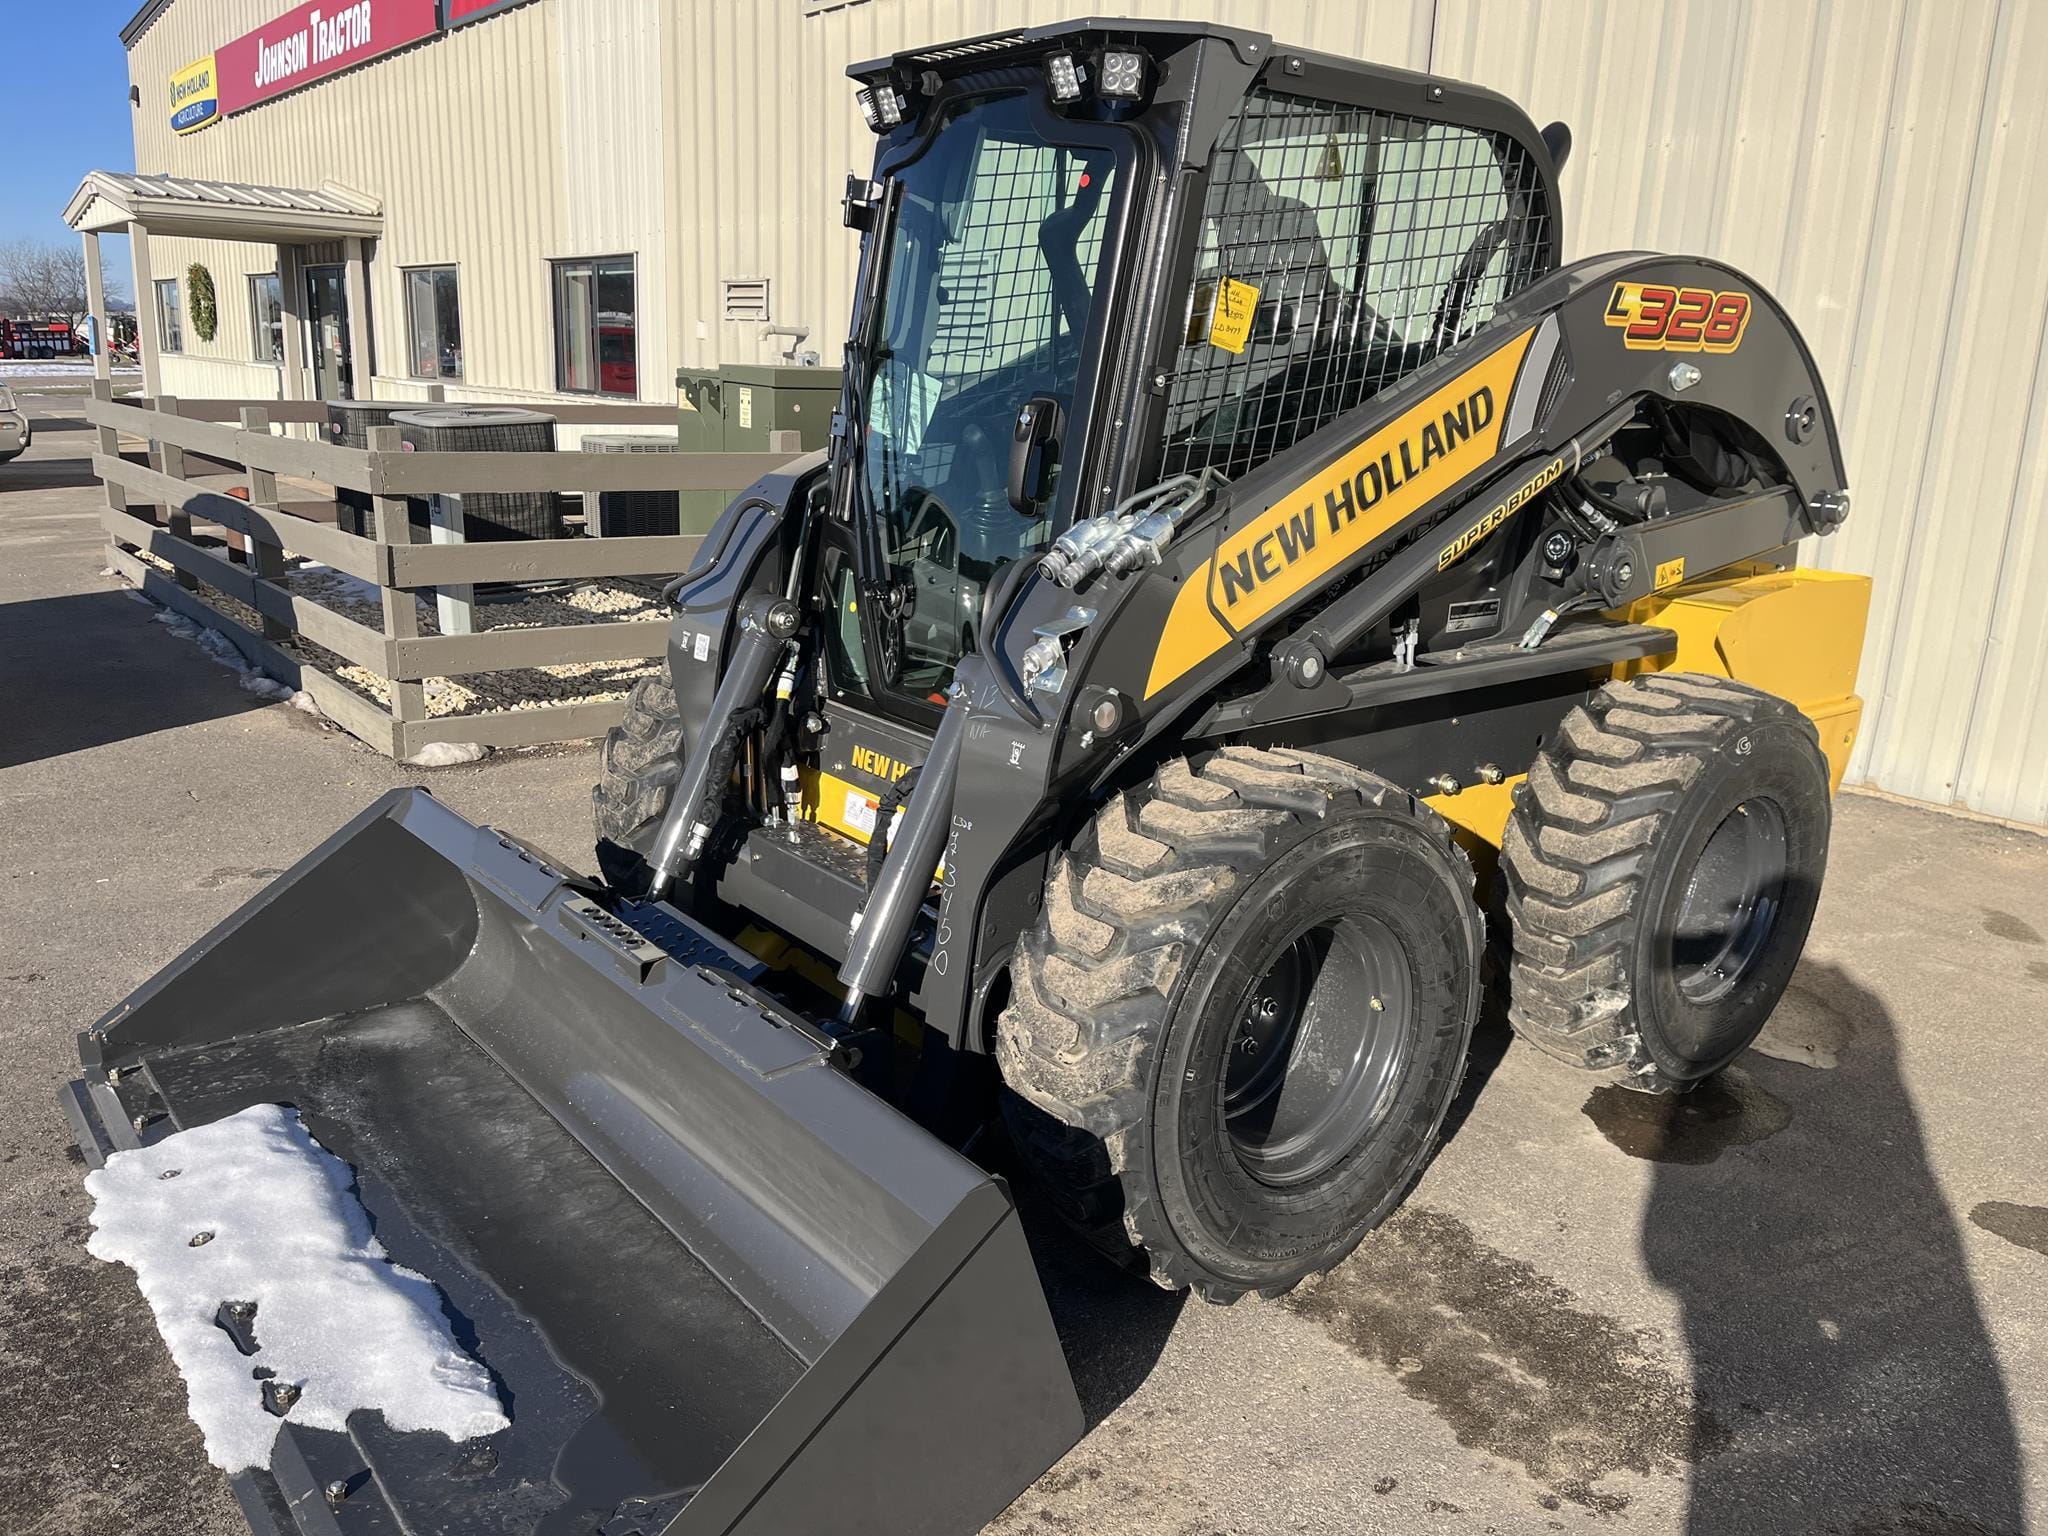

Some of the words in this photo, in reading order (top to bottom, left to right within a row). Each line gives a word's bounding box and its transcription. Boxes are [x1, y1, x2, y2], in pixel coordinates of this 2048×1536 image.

[187, 70, 210, 97] HOLLAND
[1606, 284, 1750, 347] L328
[1219, 503, 1316, 608] NEW
[1323, 384, 1495, 536] HOLLAND
[1438, 504, 1506, 572] SUPER
[1506, 458, 1563, 517] BOOM
[851, 744, 891, 780] NEW
